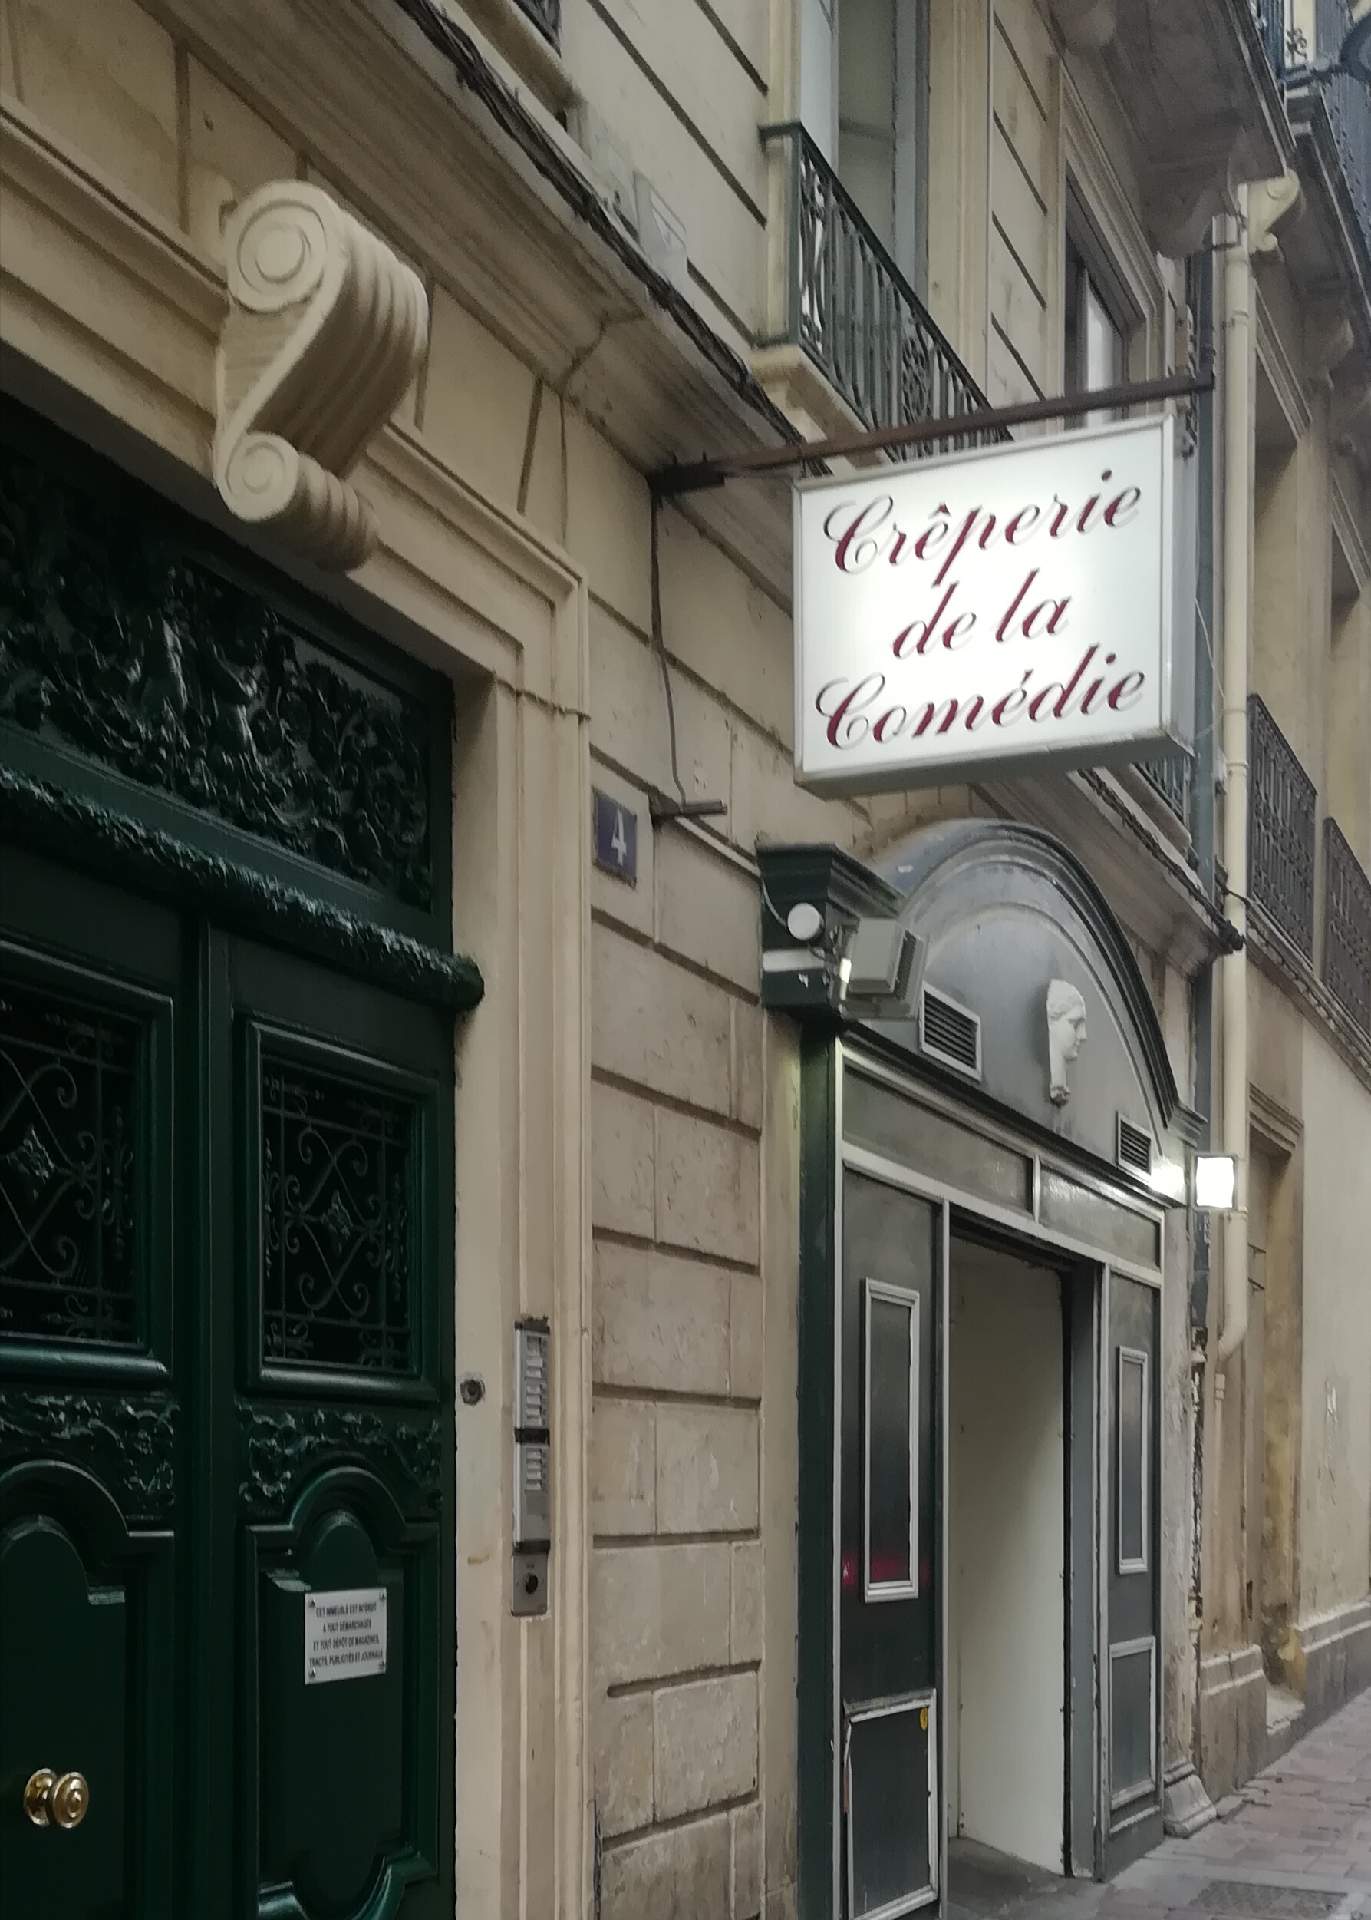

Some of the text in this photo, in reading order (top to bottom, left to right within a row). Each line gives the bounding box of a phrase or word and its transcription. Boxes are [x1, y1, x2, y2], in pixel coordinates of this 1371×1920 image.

[823, 469, 1141, 588] Crêperie
[892, 567, 1072, 659] de la
[815, 643, 1145, 750] Comédie
[610, 806, 627, 867] 4
